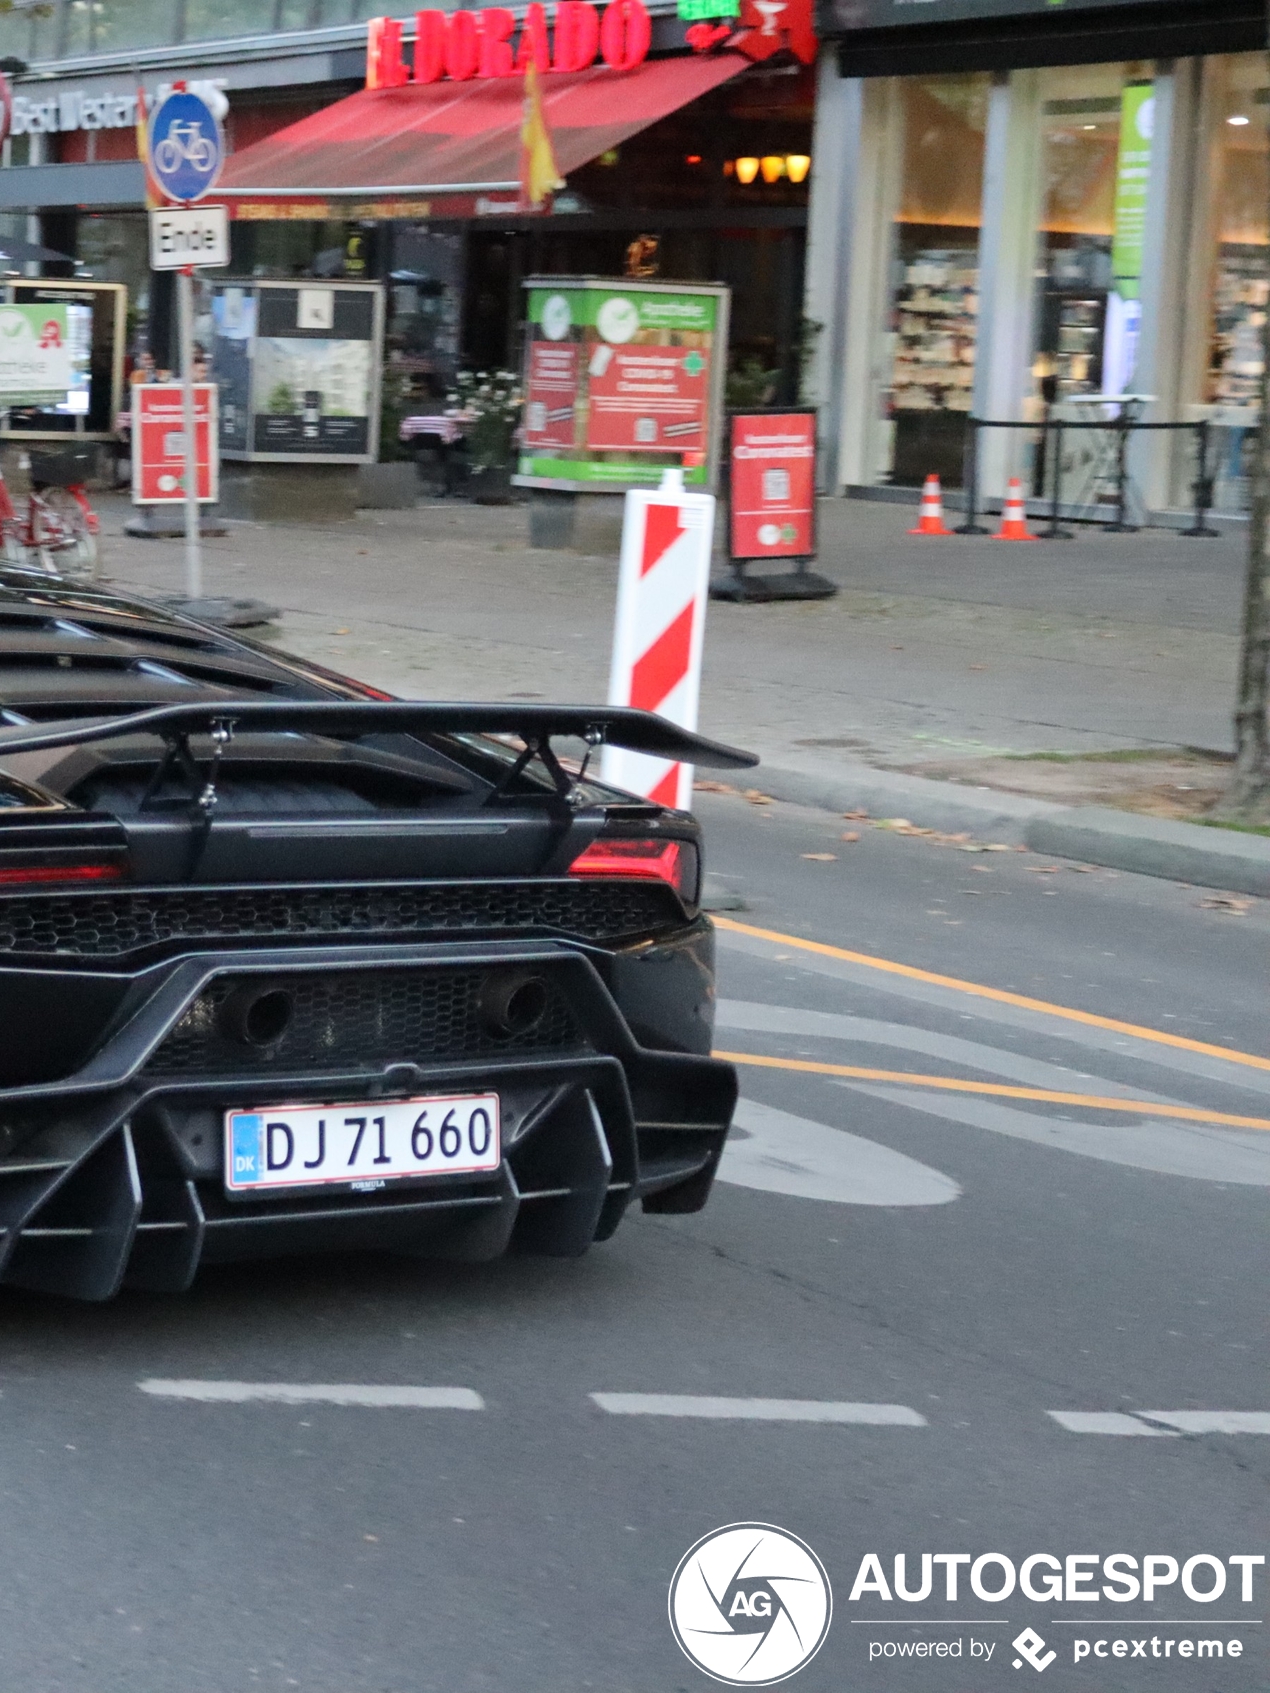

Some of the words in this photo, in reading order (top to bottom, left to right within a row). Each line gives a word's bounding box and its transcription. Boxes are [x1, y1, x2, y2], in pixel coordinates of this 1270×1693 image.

[365, 17, 410, 89] EL
[413, 0, 651, 84] DORADO
[11, 95, 59, 136] Best
[158, 221, 218, 253] Ende
[641, 302, 706, 320] Apotheke
[266, 1119, 327, 1172] DJ
[343, 1115, 392, 1167] 71
[410, 1107, 494, 1161] 660
[236, 1156, 256, 1172] DK
[351, 1180, 386, 1191] FORMULA
